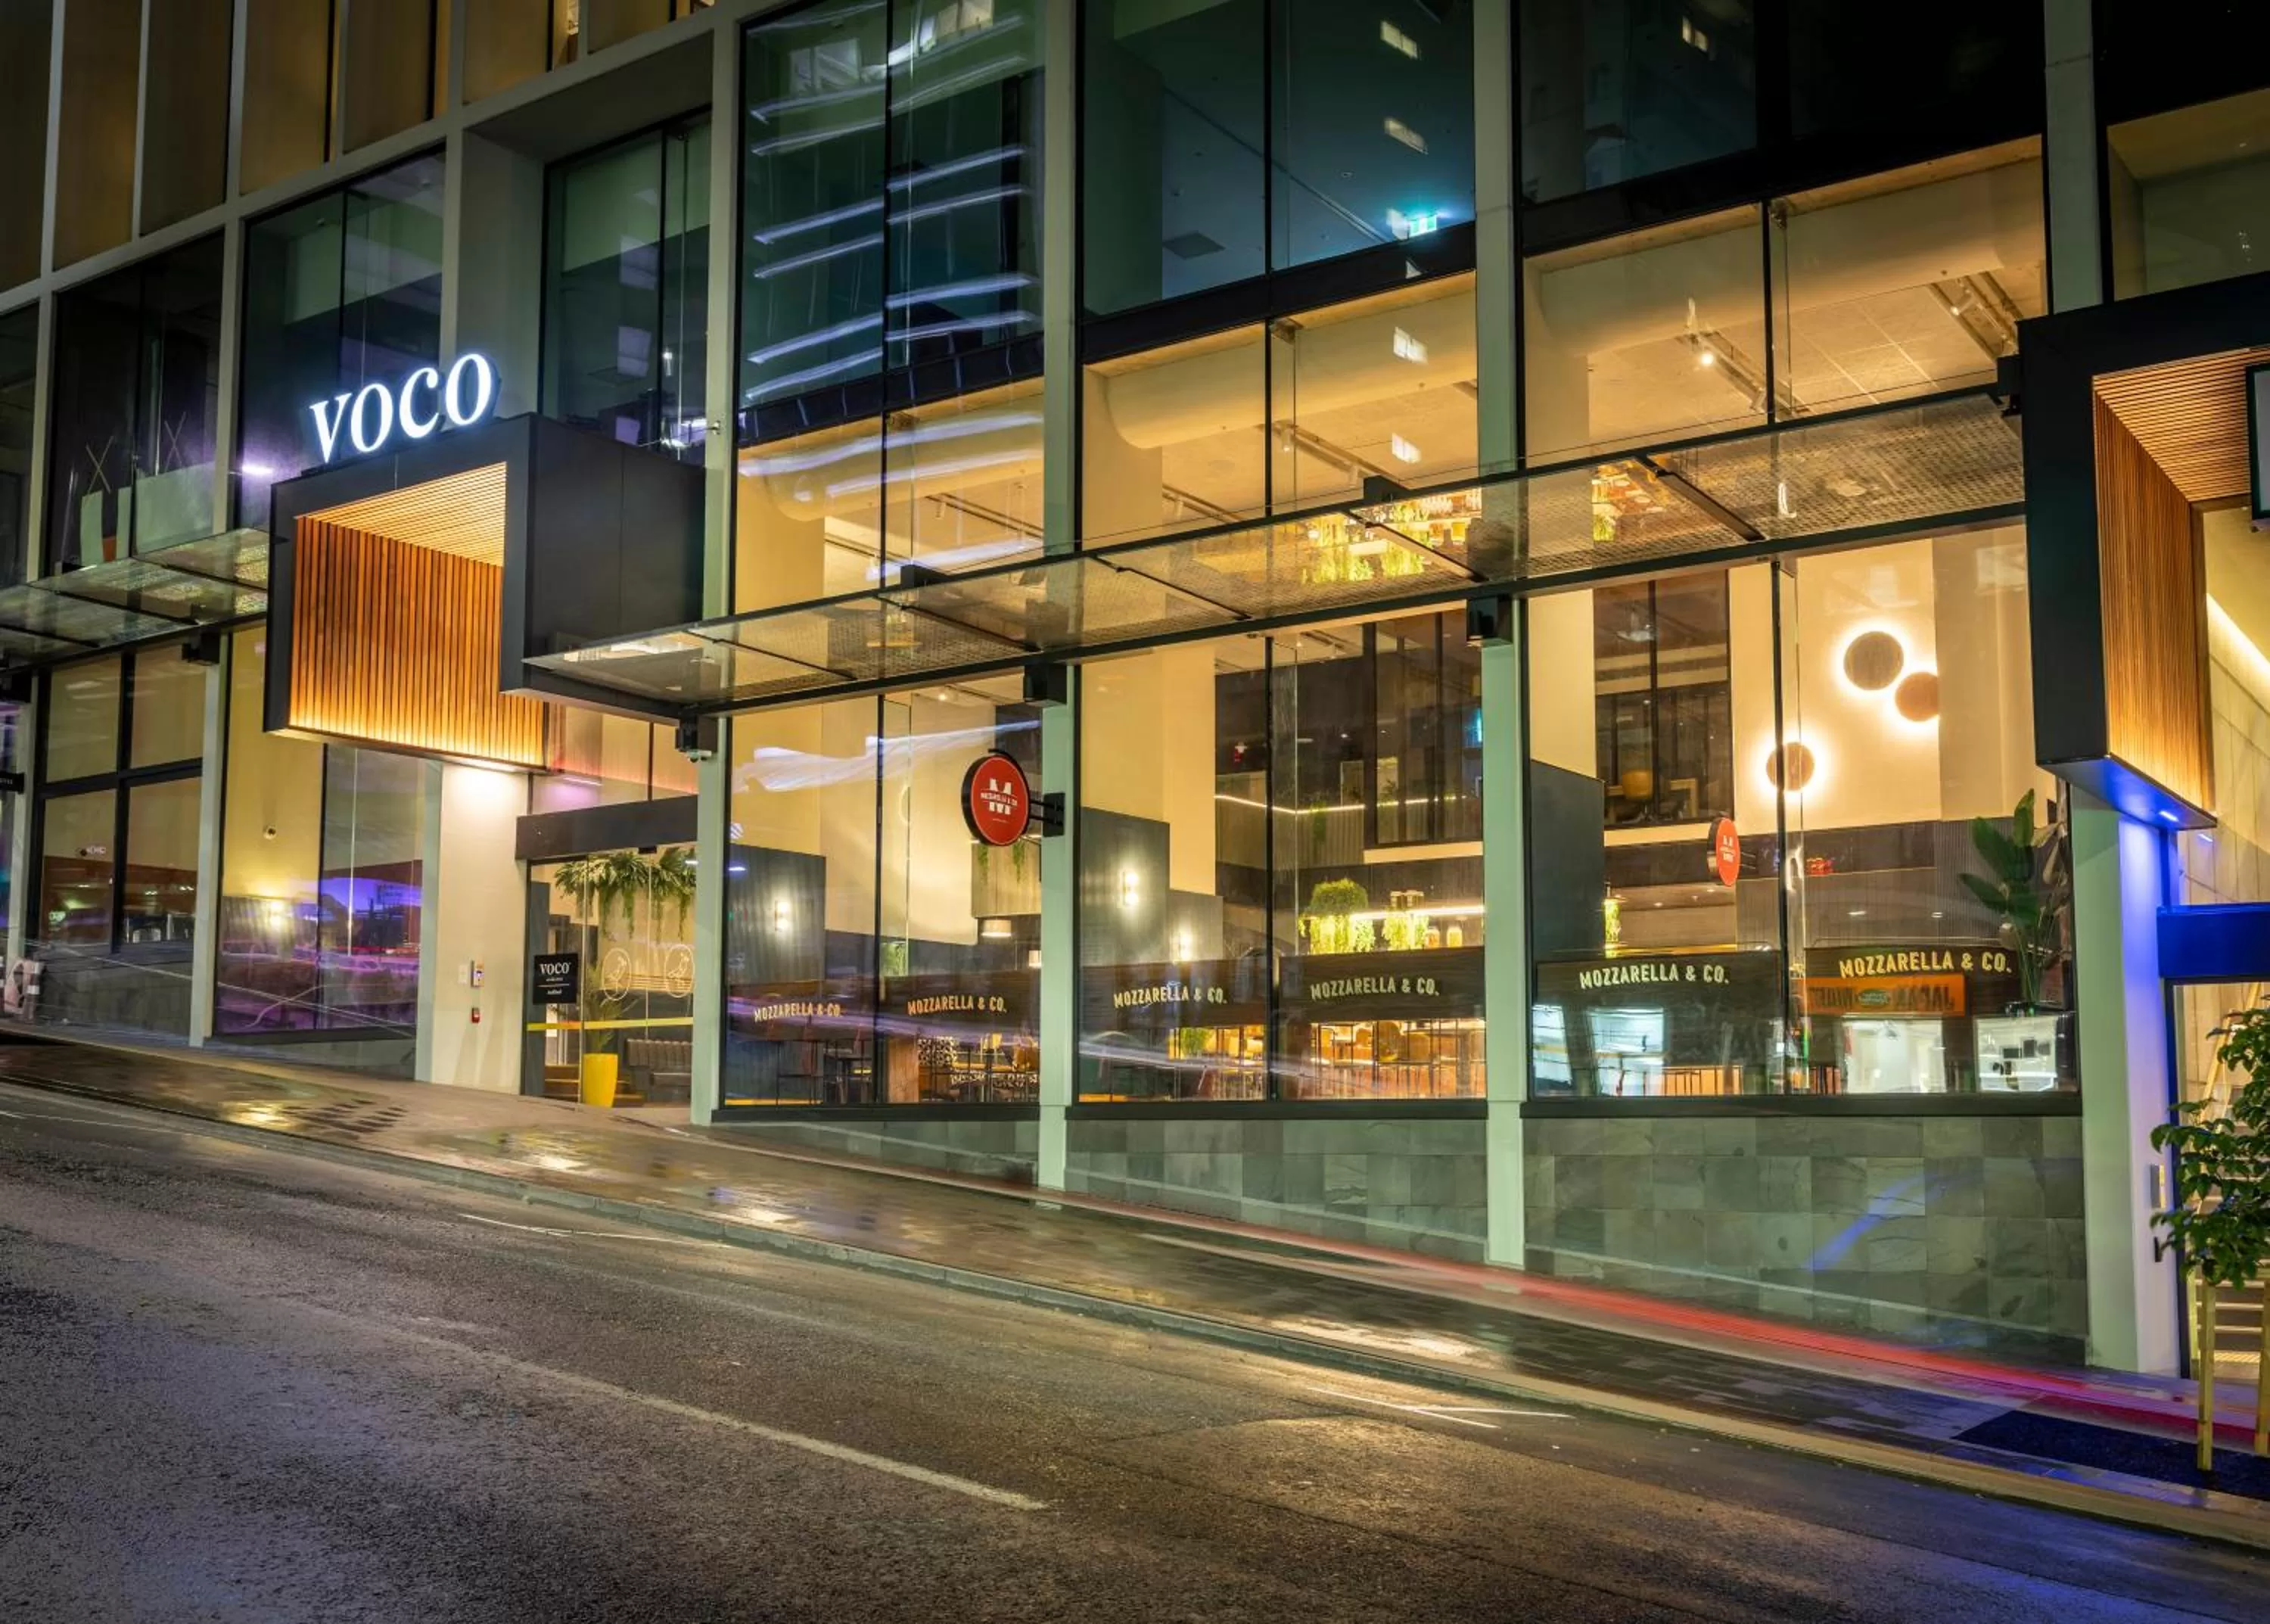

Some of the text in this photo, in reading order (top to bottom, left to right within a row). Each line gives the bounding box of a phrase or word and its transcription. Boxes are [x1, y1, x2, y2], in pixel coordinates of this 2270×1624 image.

[1839, 950, 2013, 978] MOZZARELLA & CO.
[1310, 975, 1441, 1000] MOZZARELLA & CO.
[1578, 963, 1730, 990] MOZZARELLA & CO.
[907, 995, 1008, 1016] MOZZARELLA & CO.
[1112, 986, 1228, 1009] MOZZARELLA & CO.
[754, 1002, 814, 1022] MOZZARELLA
[816, 1003, 824, 1016] &
